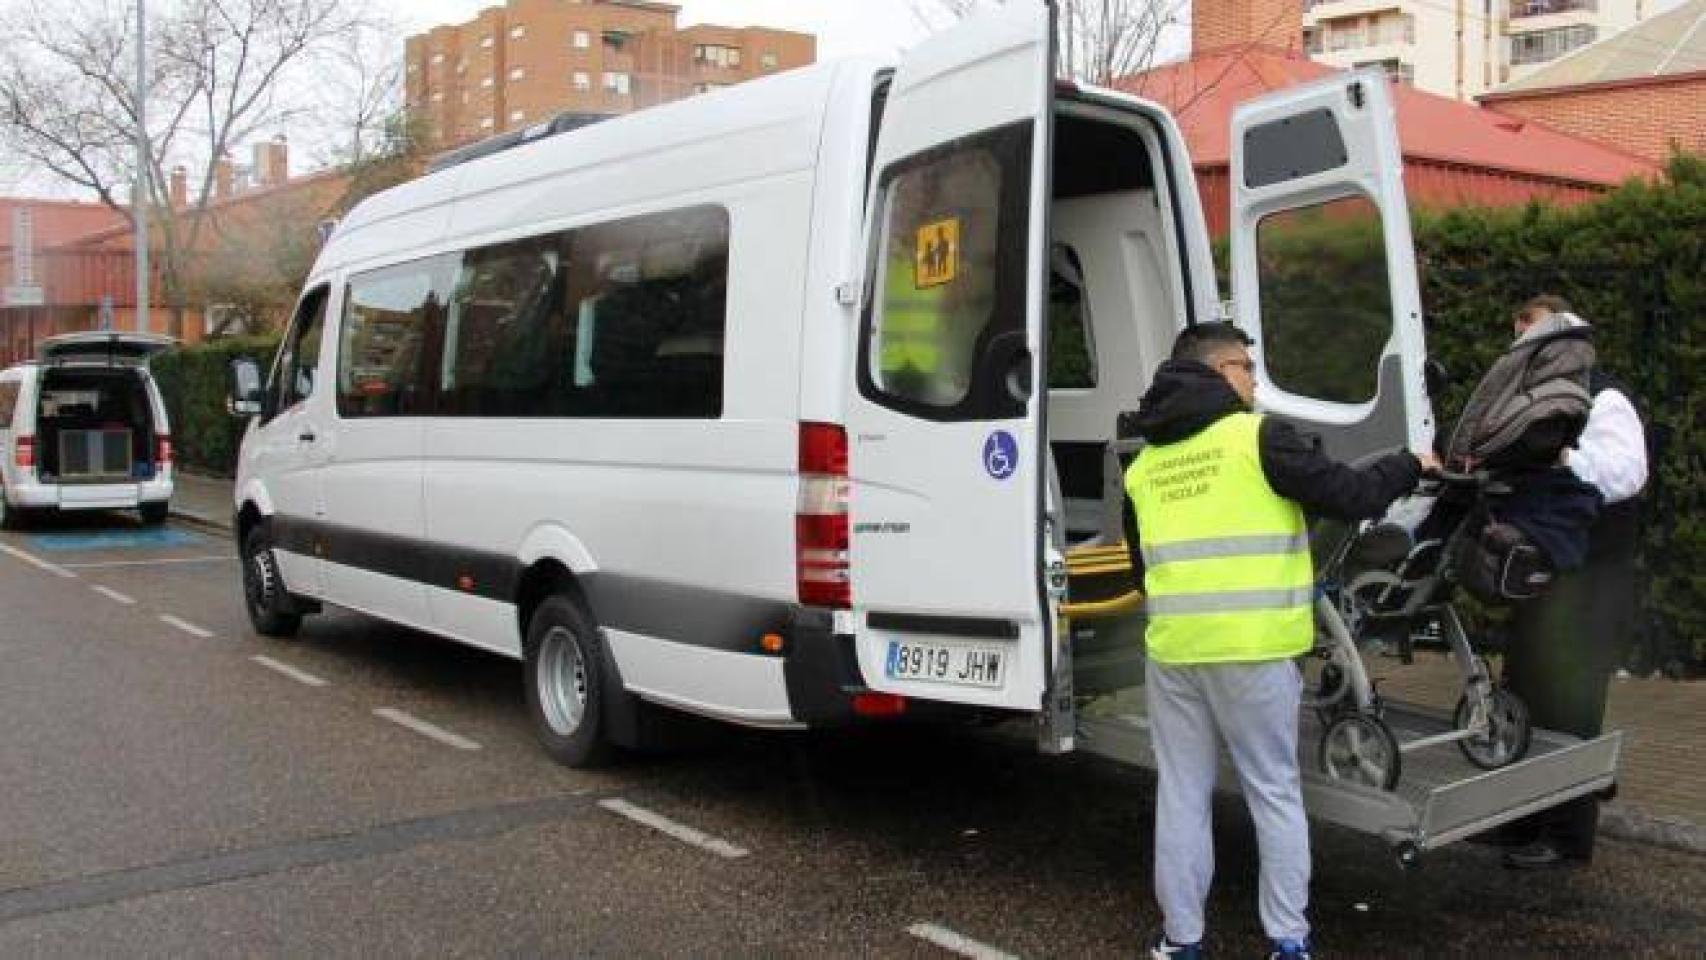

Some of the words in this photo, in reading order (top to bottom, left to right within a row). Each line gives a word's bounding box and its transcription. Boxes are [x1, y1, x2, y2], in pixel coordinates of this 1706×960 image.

[1161, 482, 1211, 502] ESCOLAR
[899, 646, 949, 677] 8919
[958, 651, 1001, 683] JHW
